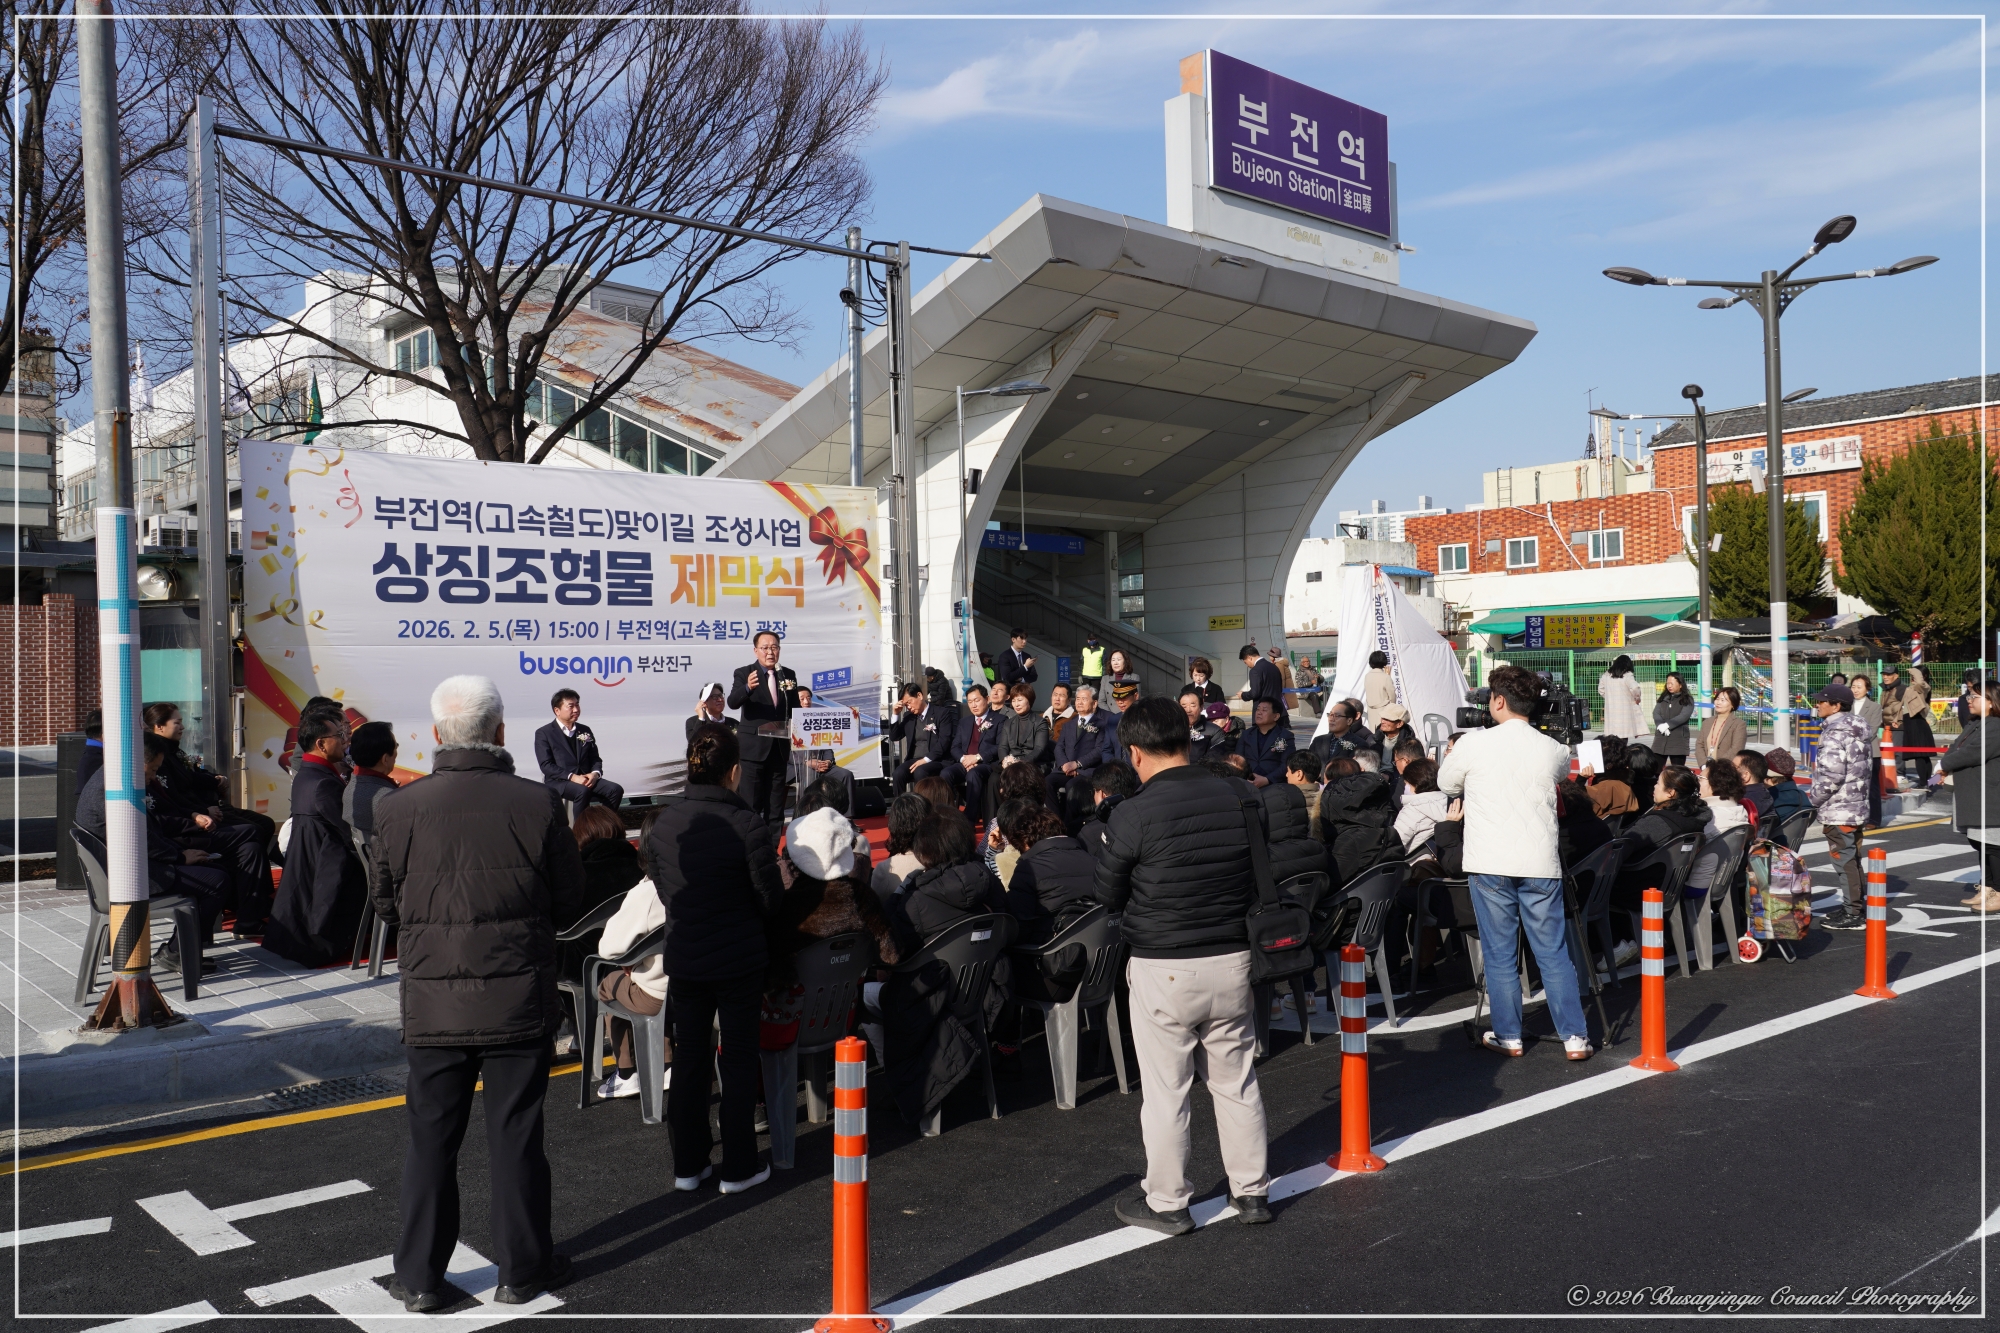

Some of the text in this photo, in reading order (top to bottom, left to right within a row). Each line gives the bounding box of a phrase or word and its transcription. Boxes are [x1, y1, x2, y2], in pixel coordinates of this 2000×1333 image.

[1238, 93, 1366, 181] 부전역
[1232, 151, 1336, 204] Bujeon Station
[1783, 466, 1817, 475] 07-9913
[374, 495, 801, 548] 부전역(고속철도)맞이길 조성사업
[372, 541, 805, 609] 상징조형물 제막식
[397, 619, 455, 639] 2026.
[463, 620, 480, 639] 2.
[488, 618, 541, 641] 5.(목)
[549, 621, 600, 639] 15:00
[616, 619, 750, 642] 부전역(고속철도)
[1528, 616, 1543, 647] 창녕집
[519, 650, 633, 681] busanjin
[636, 655, 693, 673] 부산진구
[816, 670, 846, 683] 부전역
[802, 718, 851, 731] 상징조형물
[810, 732, 843, 747] 제막식
